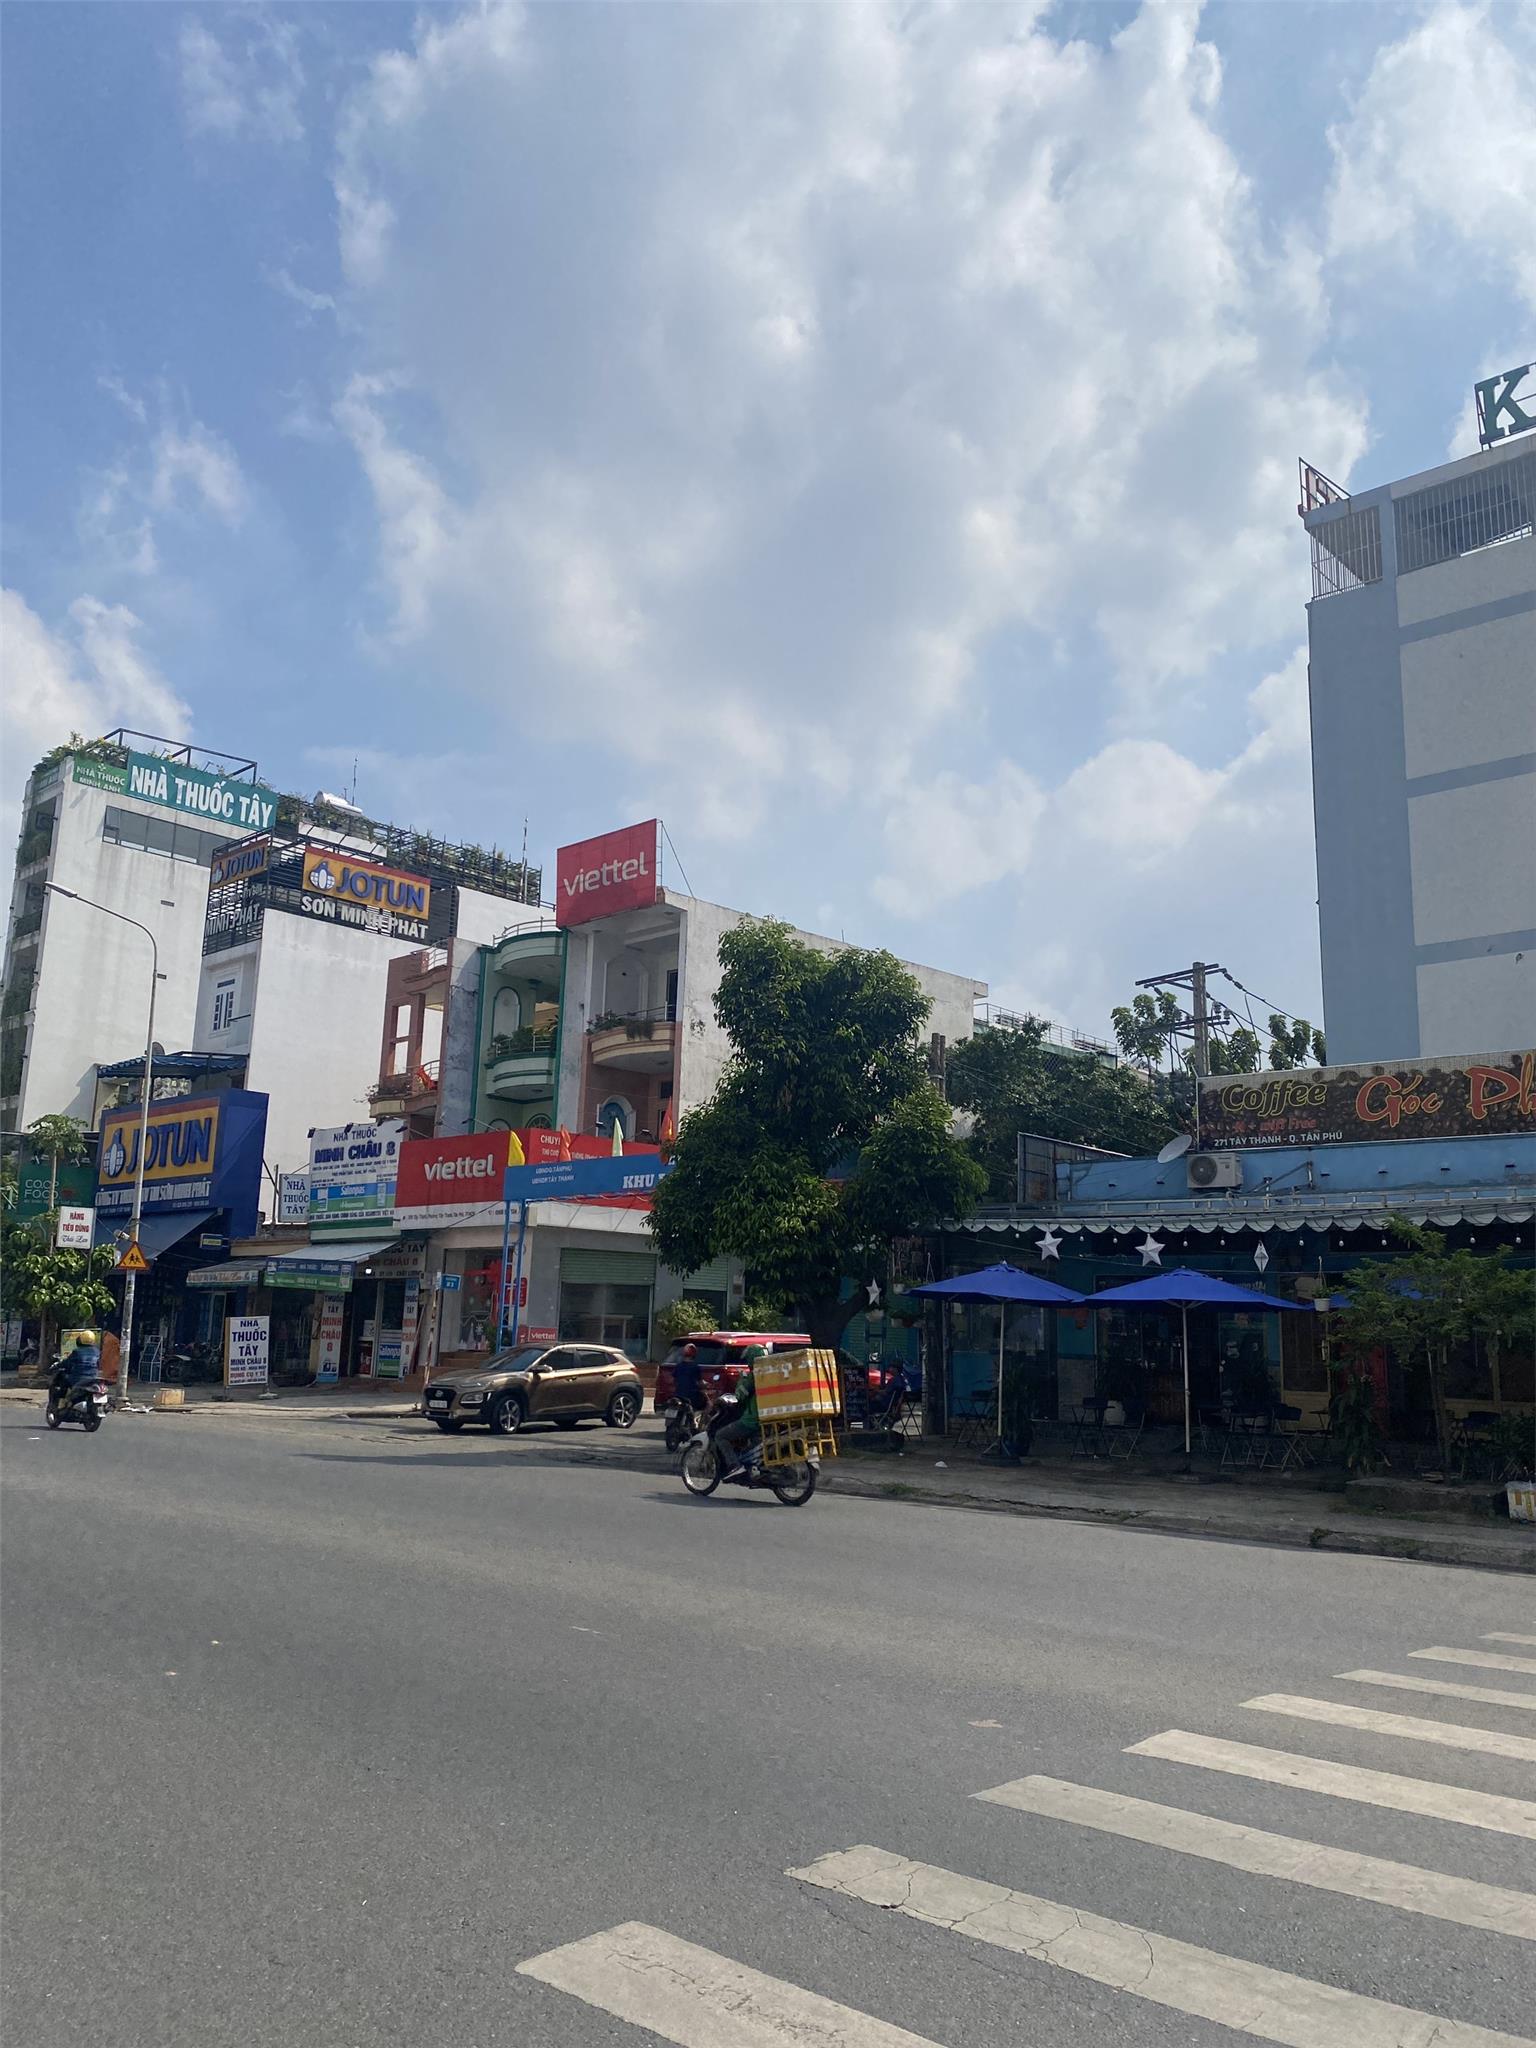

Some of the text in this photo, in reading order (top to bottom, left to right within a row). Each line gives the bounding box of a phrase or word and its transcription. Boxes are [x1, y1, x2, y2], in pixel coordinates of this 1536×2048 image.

[131, 765, 273, 828] NHÀ THUỐC TÂY
[225, 847, 265, 880] JOTUN
[563, 851, 649, 897] viettel
[336, 867, 424, 912] JOTUN
[301, 896, 428, 940] SƠN MINH PHÁT
[1222, 1080, 1327, 1117] Coffee
[1355, 1074, 1444, 1128] Góc
[352, 1127, 377, 1140] THUỐC
[1214, 1139, 1228, 1147] 271
[1229, 1136, 1247, 1146] TÂY
[1289, 1134, 1299, 1143] Q.
[1301, 1132, 1320, 1142] TÂN
[1323, 1130, 1343, 1140] PHÚ
[126, 1117, 213, 1175] JOTUN
[314, 1140, 396, 1163] MINH CHÂU 8
[424, 1154, 496, 1181] viettel
[287, 1179, 306, 1190] NHÀ
[623, 1175, 654, 1189] KHU
[284, 1191, 309, 1203] THUỐC
[69, 1211, 84, 1220] HÀNG
[286, 1205, 306, 1214] TÂY
[75, 1222, 89, 1232] DÙNG
[240, 1320, 259, 1328] NHÀ
[321, 1316, 343, 1326] MINH
[232, 1327, 267, 1342] THUỐC
[321, 1328, 341, 1340] CHÂU
[531, 1332, 556, 1340] viettel
[239, 1344, 258, 1356] TÂY
[326, 1342, 333, 1352] 8
